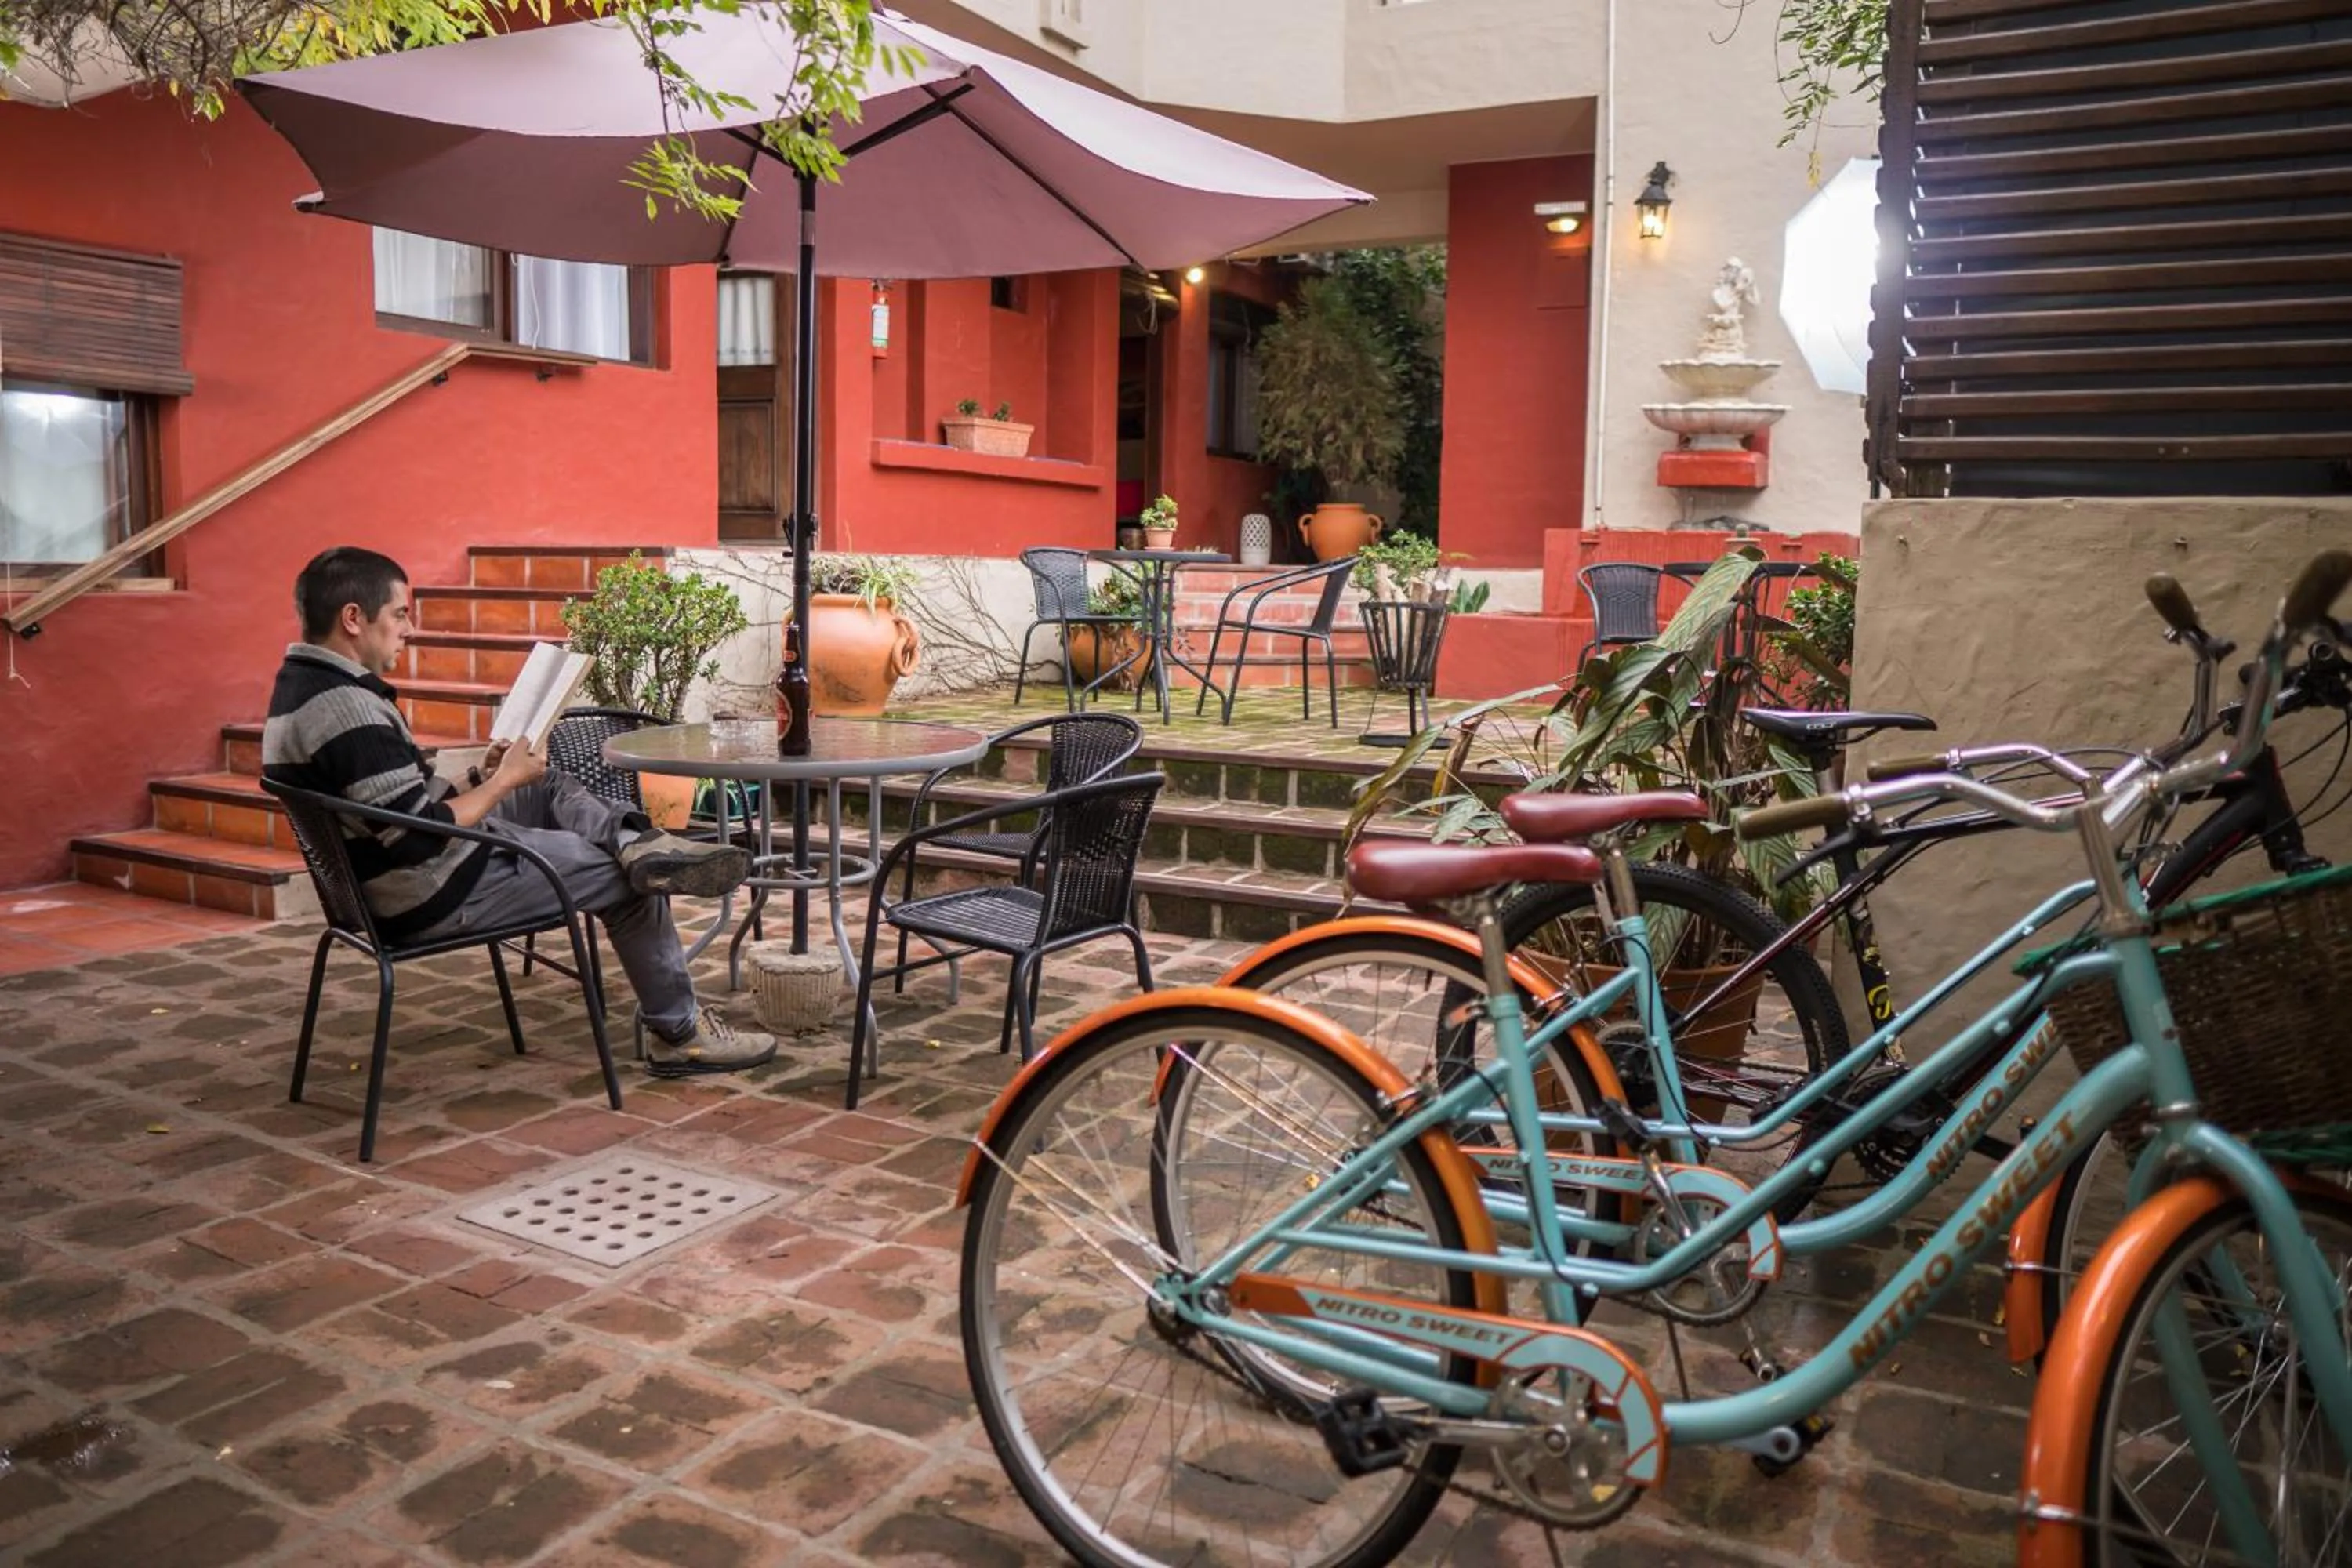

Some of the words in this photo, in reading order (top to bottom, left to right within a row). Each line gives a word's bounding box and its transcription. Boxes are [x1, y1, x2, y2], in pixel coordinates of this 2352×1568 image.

[1926, 1086, 2005, 1176] NITRO
[2005, 1018, 2058, 1081] SWE
[1567, 1163, 1647, 1182] SWEE
[1848, 1253, 1953, 1368] NITRO
[1956, 1109, 2076, 1249] SWEET
[1316, 1298, 1402, 1323] NITRO
[1406, 1315, 1514, 1345] SWEET
